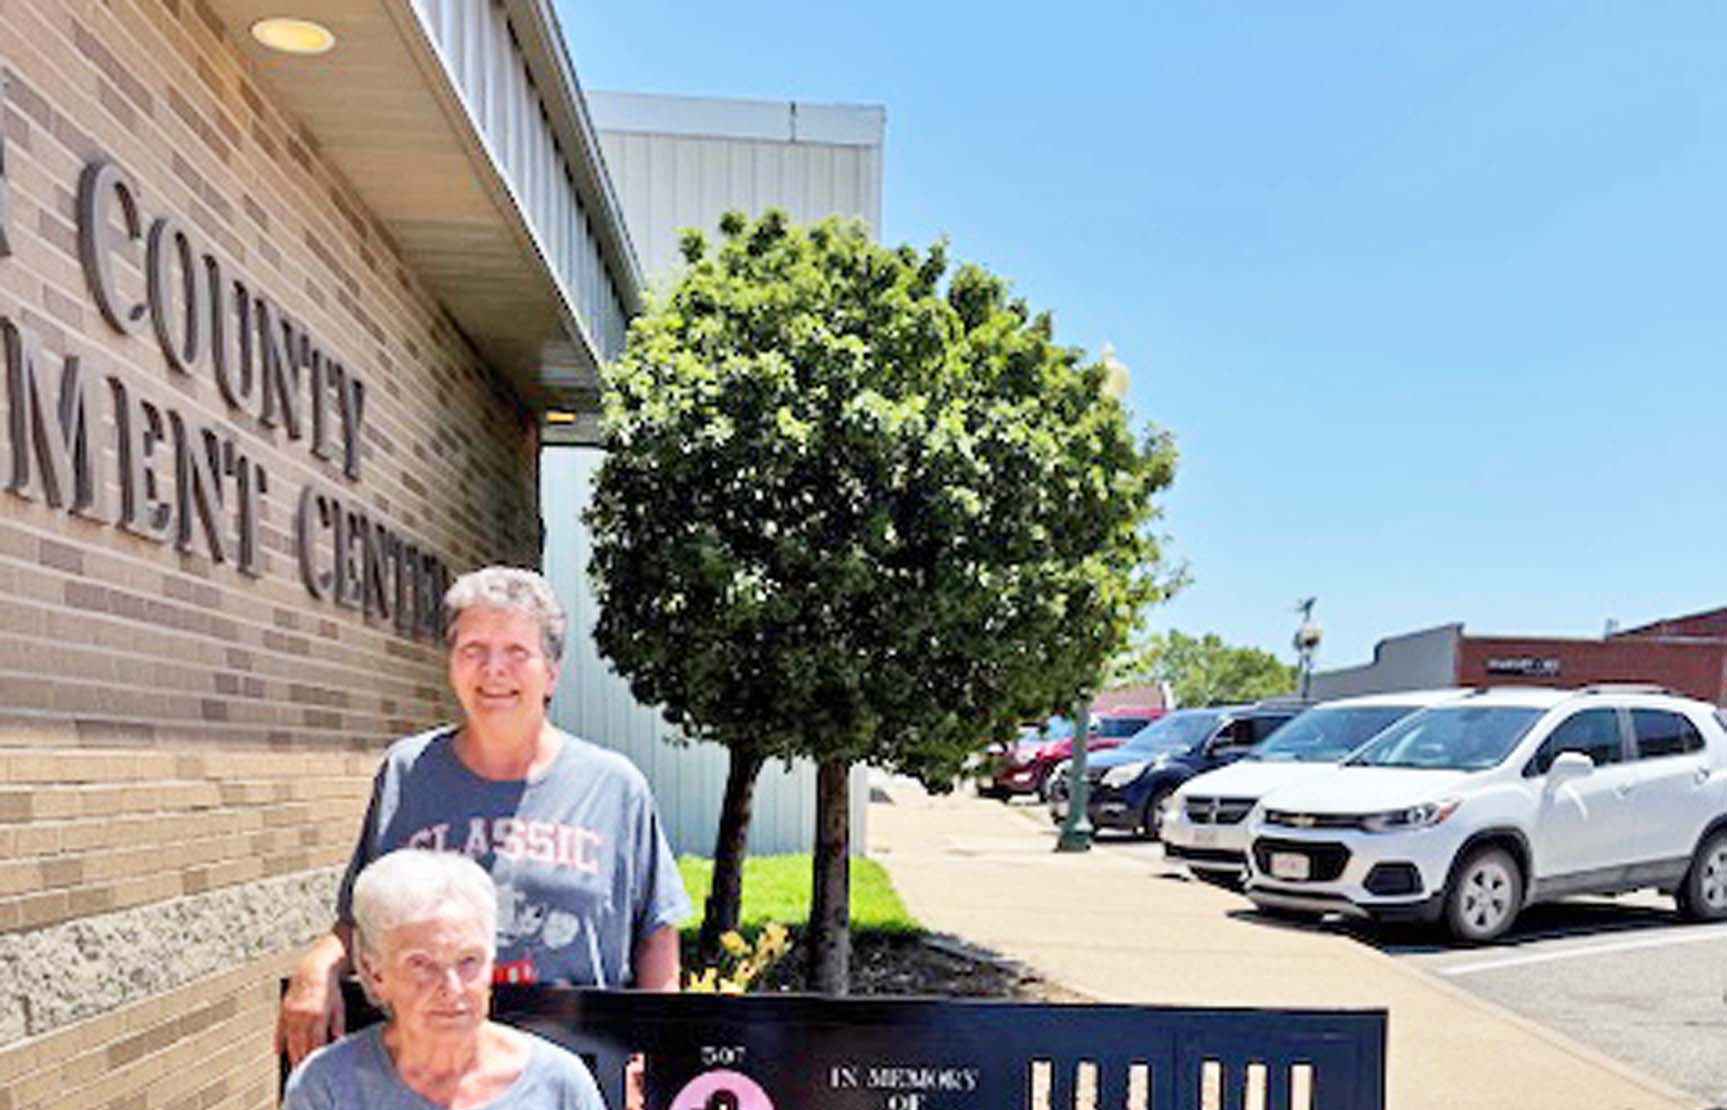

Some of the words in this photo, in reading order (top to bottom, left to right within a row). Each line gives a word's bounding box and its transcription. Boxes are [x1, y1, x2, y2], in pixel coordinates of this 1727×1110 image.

[77, 158, 366, 482] COUNTY
[405, 816, 601, 876] CLASSIC
[701, 1045, 747, 1067] 507
[830, 1067, 858, 1089] IN
[867, 1067, 980, 1091] MEMORY
